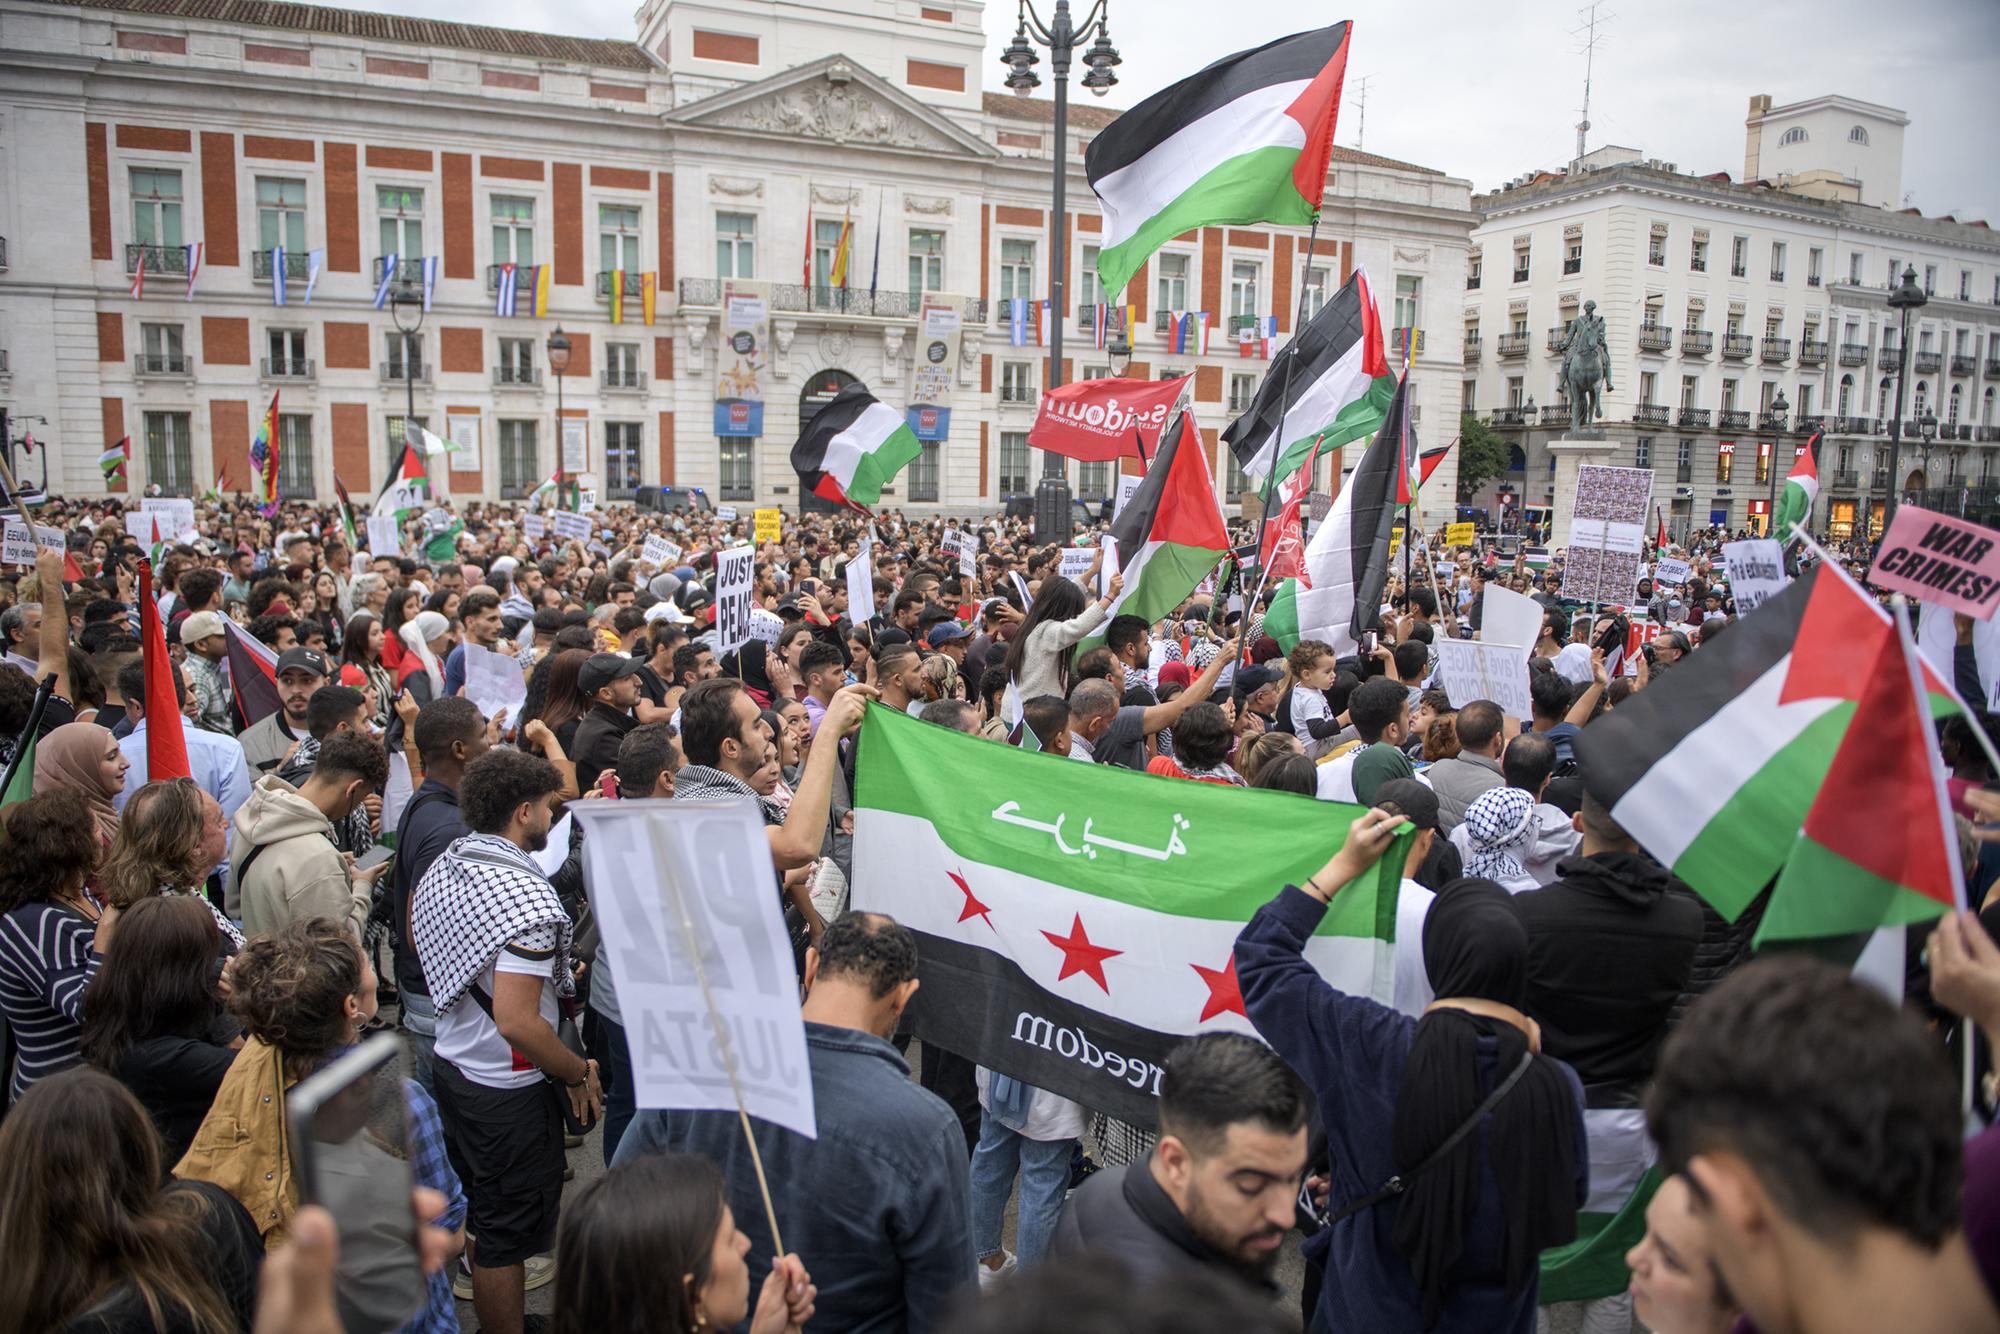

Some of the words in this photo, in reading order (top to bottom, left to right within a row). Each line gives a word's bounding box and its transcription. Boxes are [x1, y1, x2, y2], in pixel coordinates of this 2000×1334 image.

[1719, 445, 1735, 453] KFC
[1918, 522, 1994, 566] WAR
[721, 554, 754, 588] JUST
[1878, 546, 2000, 605] CRIMES!
